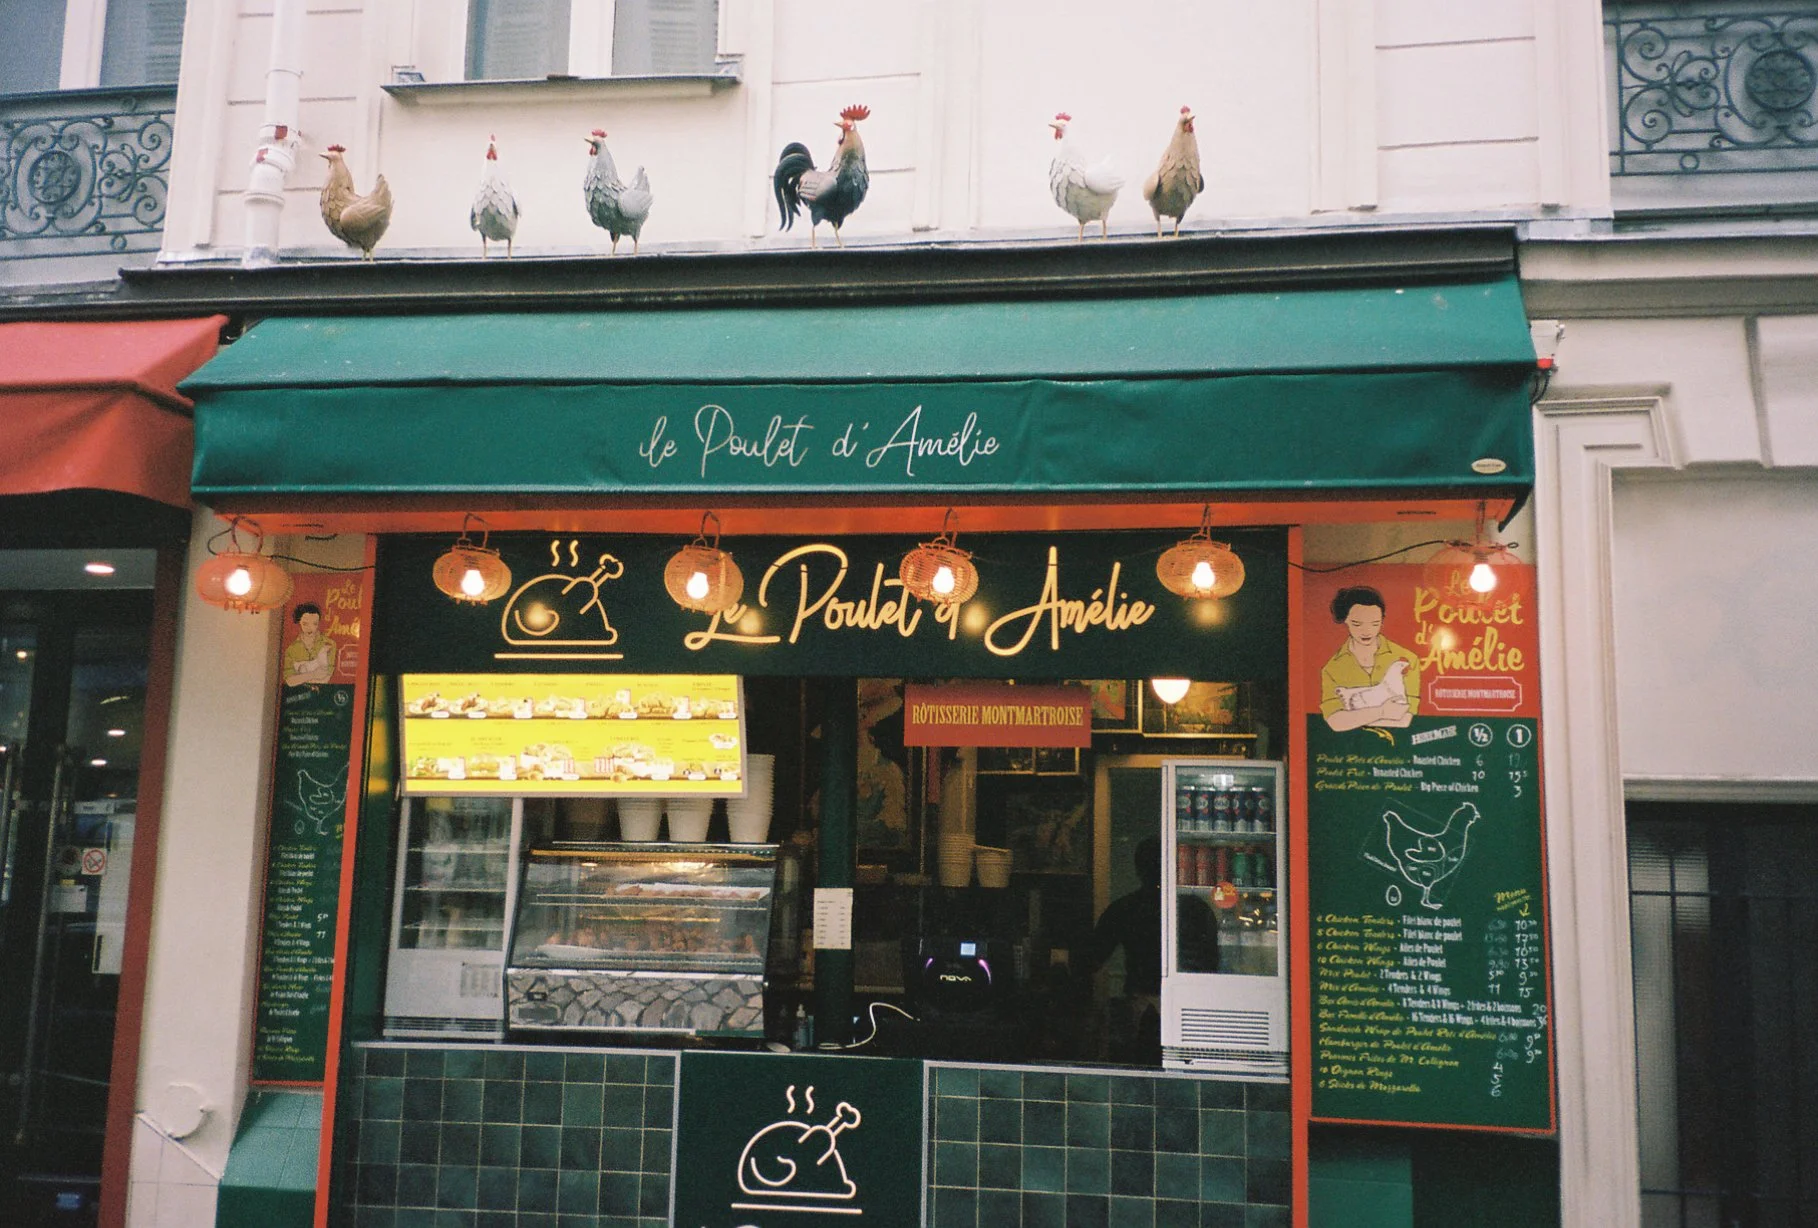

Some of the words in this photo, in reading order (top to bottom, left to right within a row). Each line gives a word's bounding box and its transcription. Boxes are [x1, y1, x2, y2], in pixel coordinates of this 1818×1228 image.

[639, 416, 678, 468] le
[695, 404, 815, 479] Poulet
[758, 544, 923, 645] Poulet
[1420, 626, 1525, 675] Amélie
[912, 702, 979, 725] RÔTISSERIE
[981, 705, 1084, 726] MONTMARTROISE
[1515, 728, 1523, 744] 1
